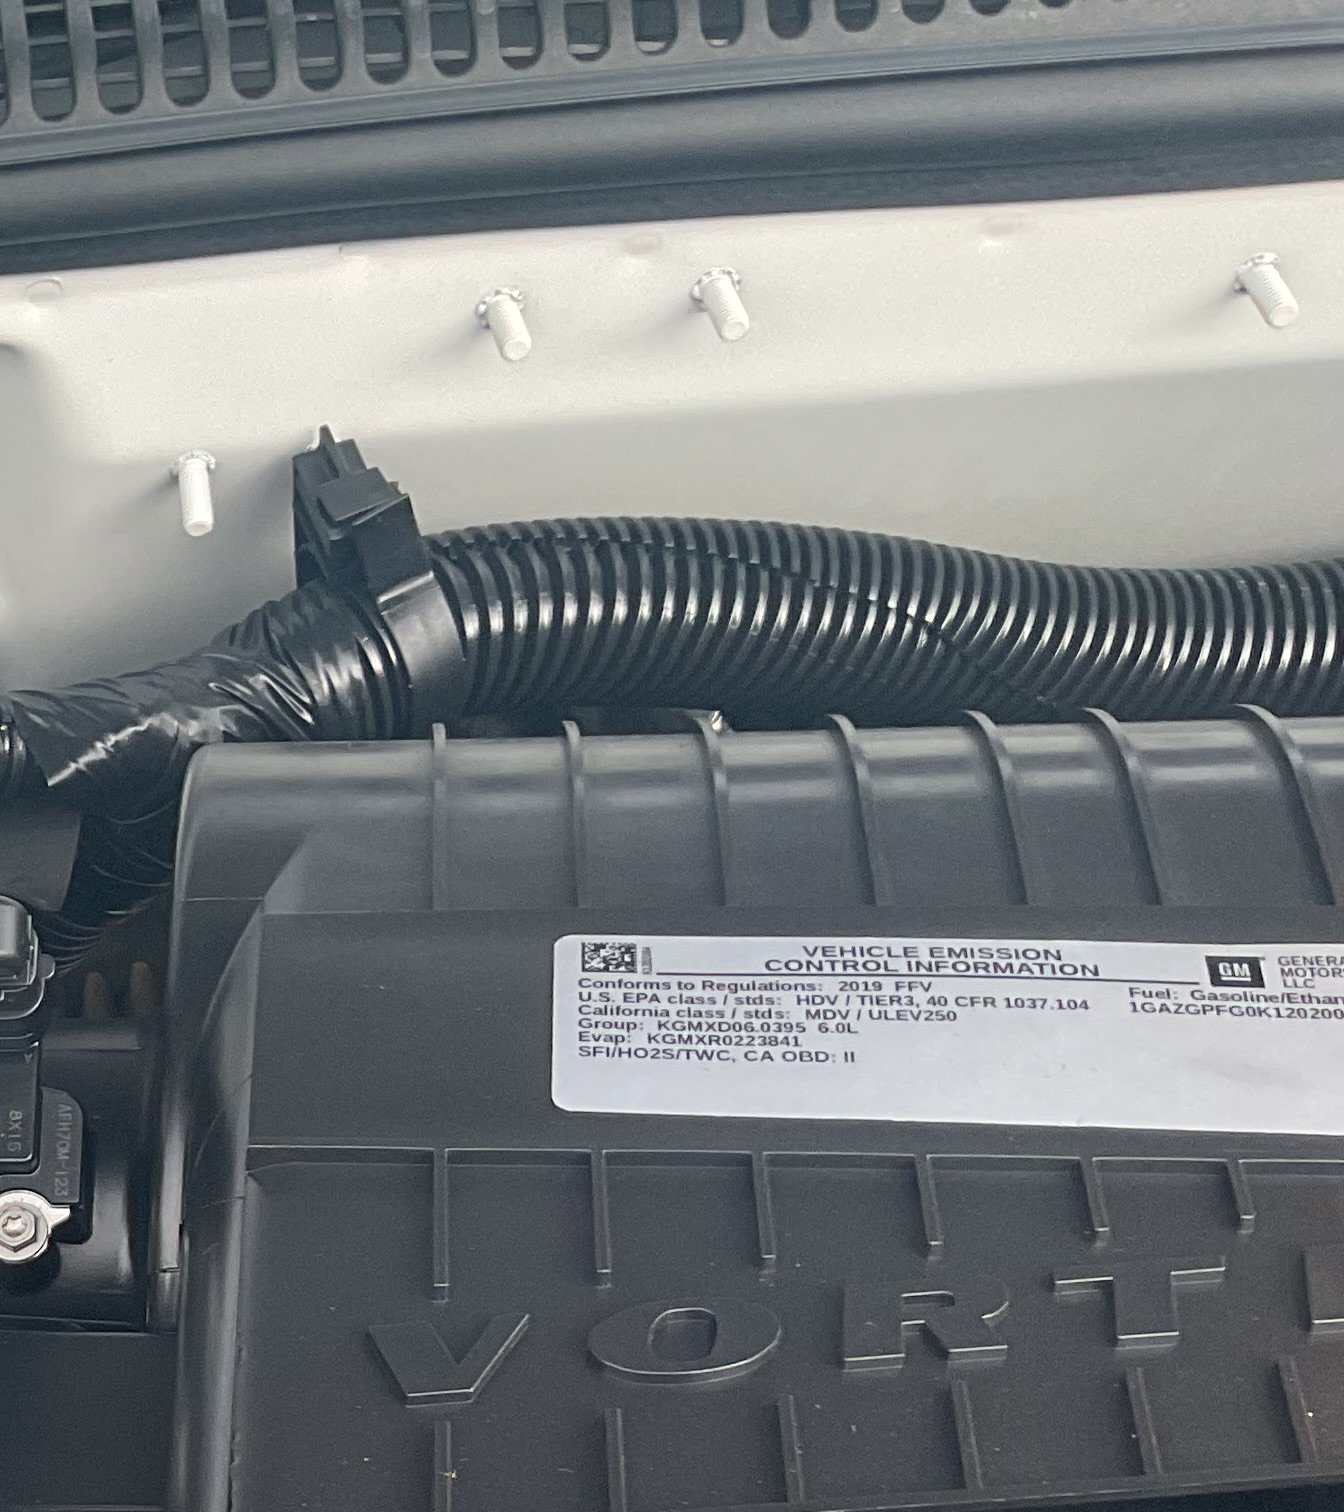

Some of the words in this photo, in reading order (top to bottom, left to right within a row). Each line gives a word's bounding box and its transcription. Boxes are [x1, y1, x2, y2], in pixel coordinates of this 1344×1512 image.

[802, 944, 920, 958] VEHICLE
[928, 946, 1063, 961] EMISSION
[763, 958, 900, 973] CONTROL
[906, 961, 1101, 977] INFORMATION
[1218, 961, 1252, 978] GM
[1280, 967, 1344, 978] MOTOR
[578, 977, 672, 990] Conforms
[677, 980, 695, 990] to
[701, 979, 823, 995] Regulations:
[838, 981, 883, 992] 2019
[894, 981, 932, 993] FFV
[1283, 979, 1316, 989] LLC
[578, 991, 616, 1003] U.S.
[623, 992, 661, 1004] EPA
[667, 993, 718, 1005] class
[723, 993, 729, 1006] /
[734, 994, 783, 1006] stds:
[796, 994, 840, 1006] HDV
[845, 994, 851, 1006] /
[856, 994, 921, 1008] TIER3,
[926, 995, 949, 1007] 40
[954, 996, 997, 1009] CFR
[1003, 997, 1091, 1011] 1037.104
[1128, 986, 1179, 1000] Fuel:
[578, 1004, 671, 1017] California
[676, 1006, 726, 1019] class
[730, 1007, 737, 1020] /
[743, 1007, 791, 1020] stds:
[806, 1009, 851, 1021] MDV
[856, 1009, 862, 1021] /
[868, 1009, 958, 1022] ULEV250
[578, 1017, 645, 1033] Group:
[657, 1020, 807, 1033] KGMXD06.0395
[817, 1022, 859, 1034] 6.0L
[578, 1030, 632, 1045] Evap:
[647, 1032, 801, 1047] KGMXR0223841
[578, 1045, 737, 1063] SFI/HO2S/TWC,
[743, 1049, 775, 1062] CA
[781, 1050, 837, 1064] OBD:
[843, 1050, 856, 1063] II
